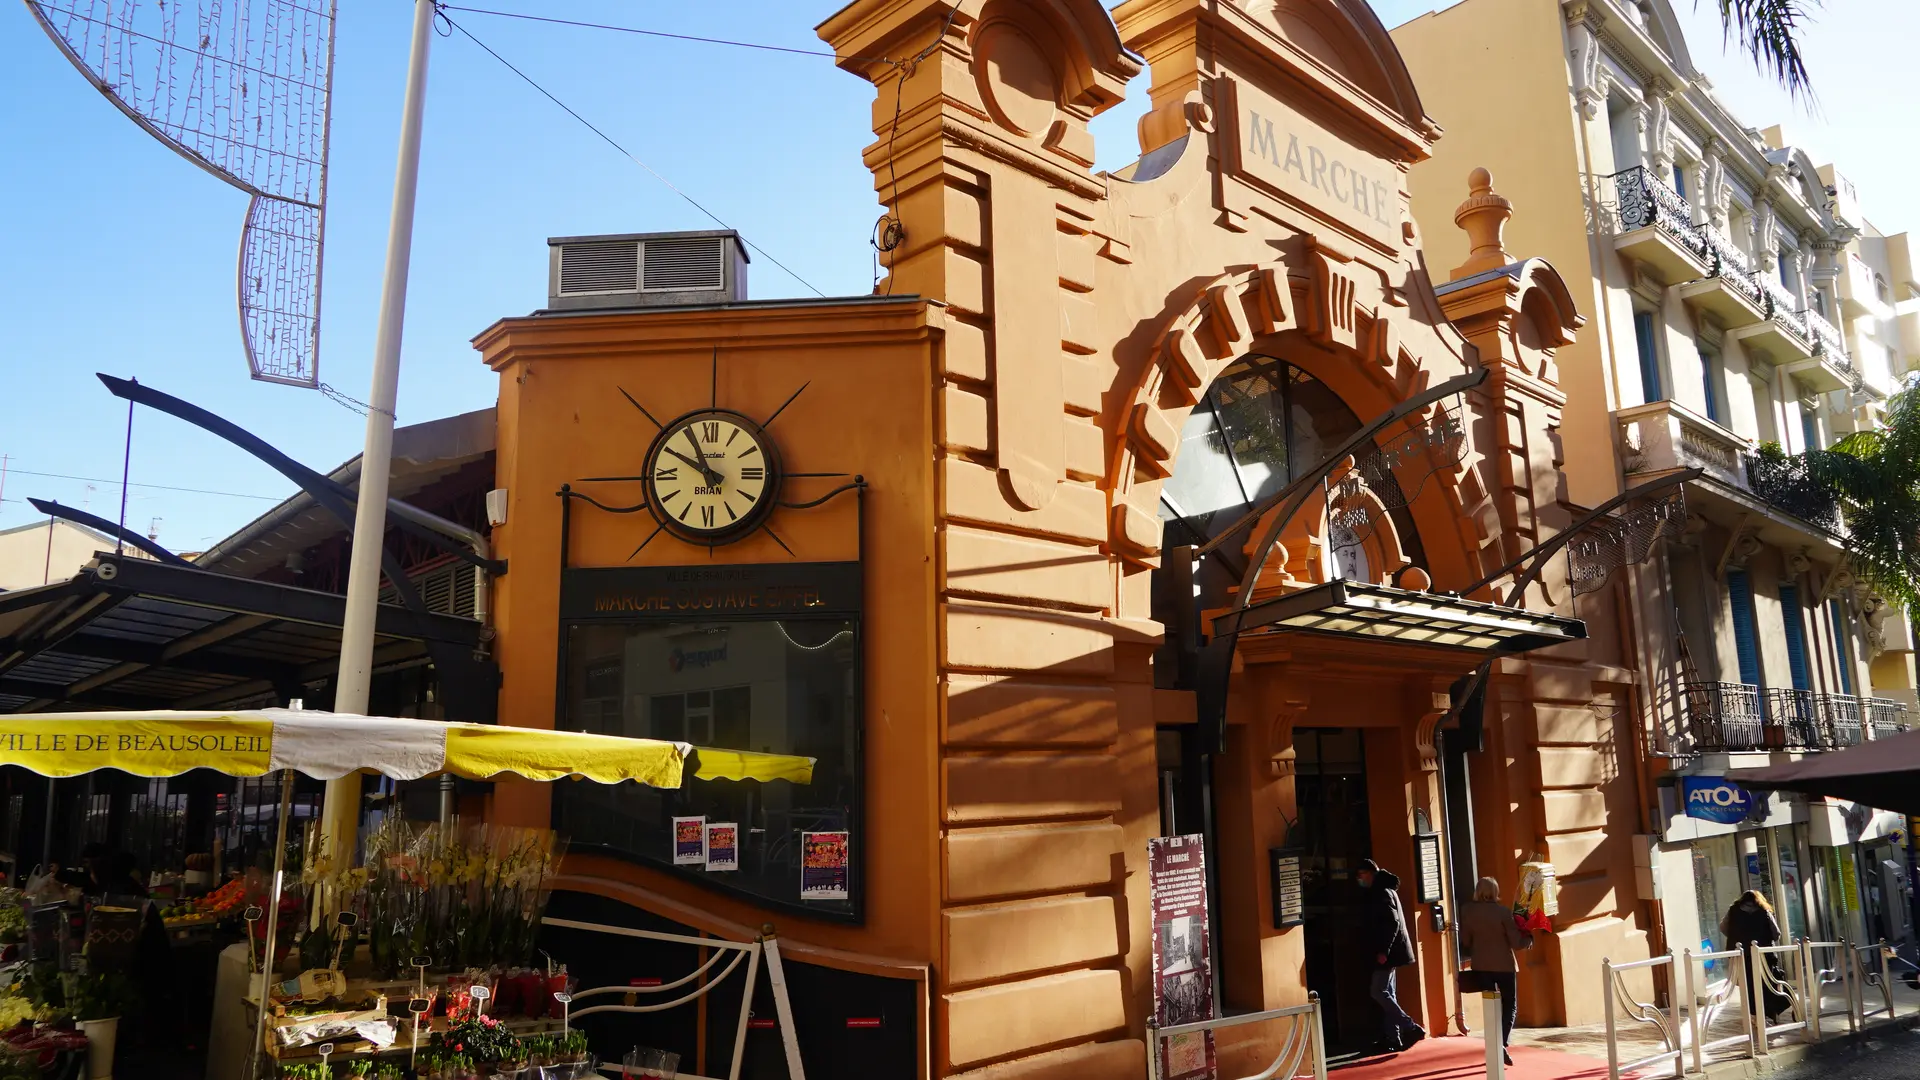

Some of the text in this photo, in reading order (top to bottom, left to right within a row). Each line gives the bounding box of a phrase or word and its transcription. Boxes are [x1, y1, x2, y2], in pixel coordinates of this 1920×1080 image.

[1248, 109, 1391, 228] MARCHÉ
[694, 486, 722, 495] BRIAN
[75, 734, 110, 751] DE
[118, 734, 269, 753] BEAUSOLEIL
[1689, 786, 1746, 806] ATOL
[1166, 855, 1172, 864] LE
